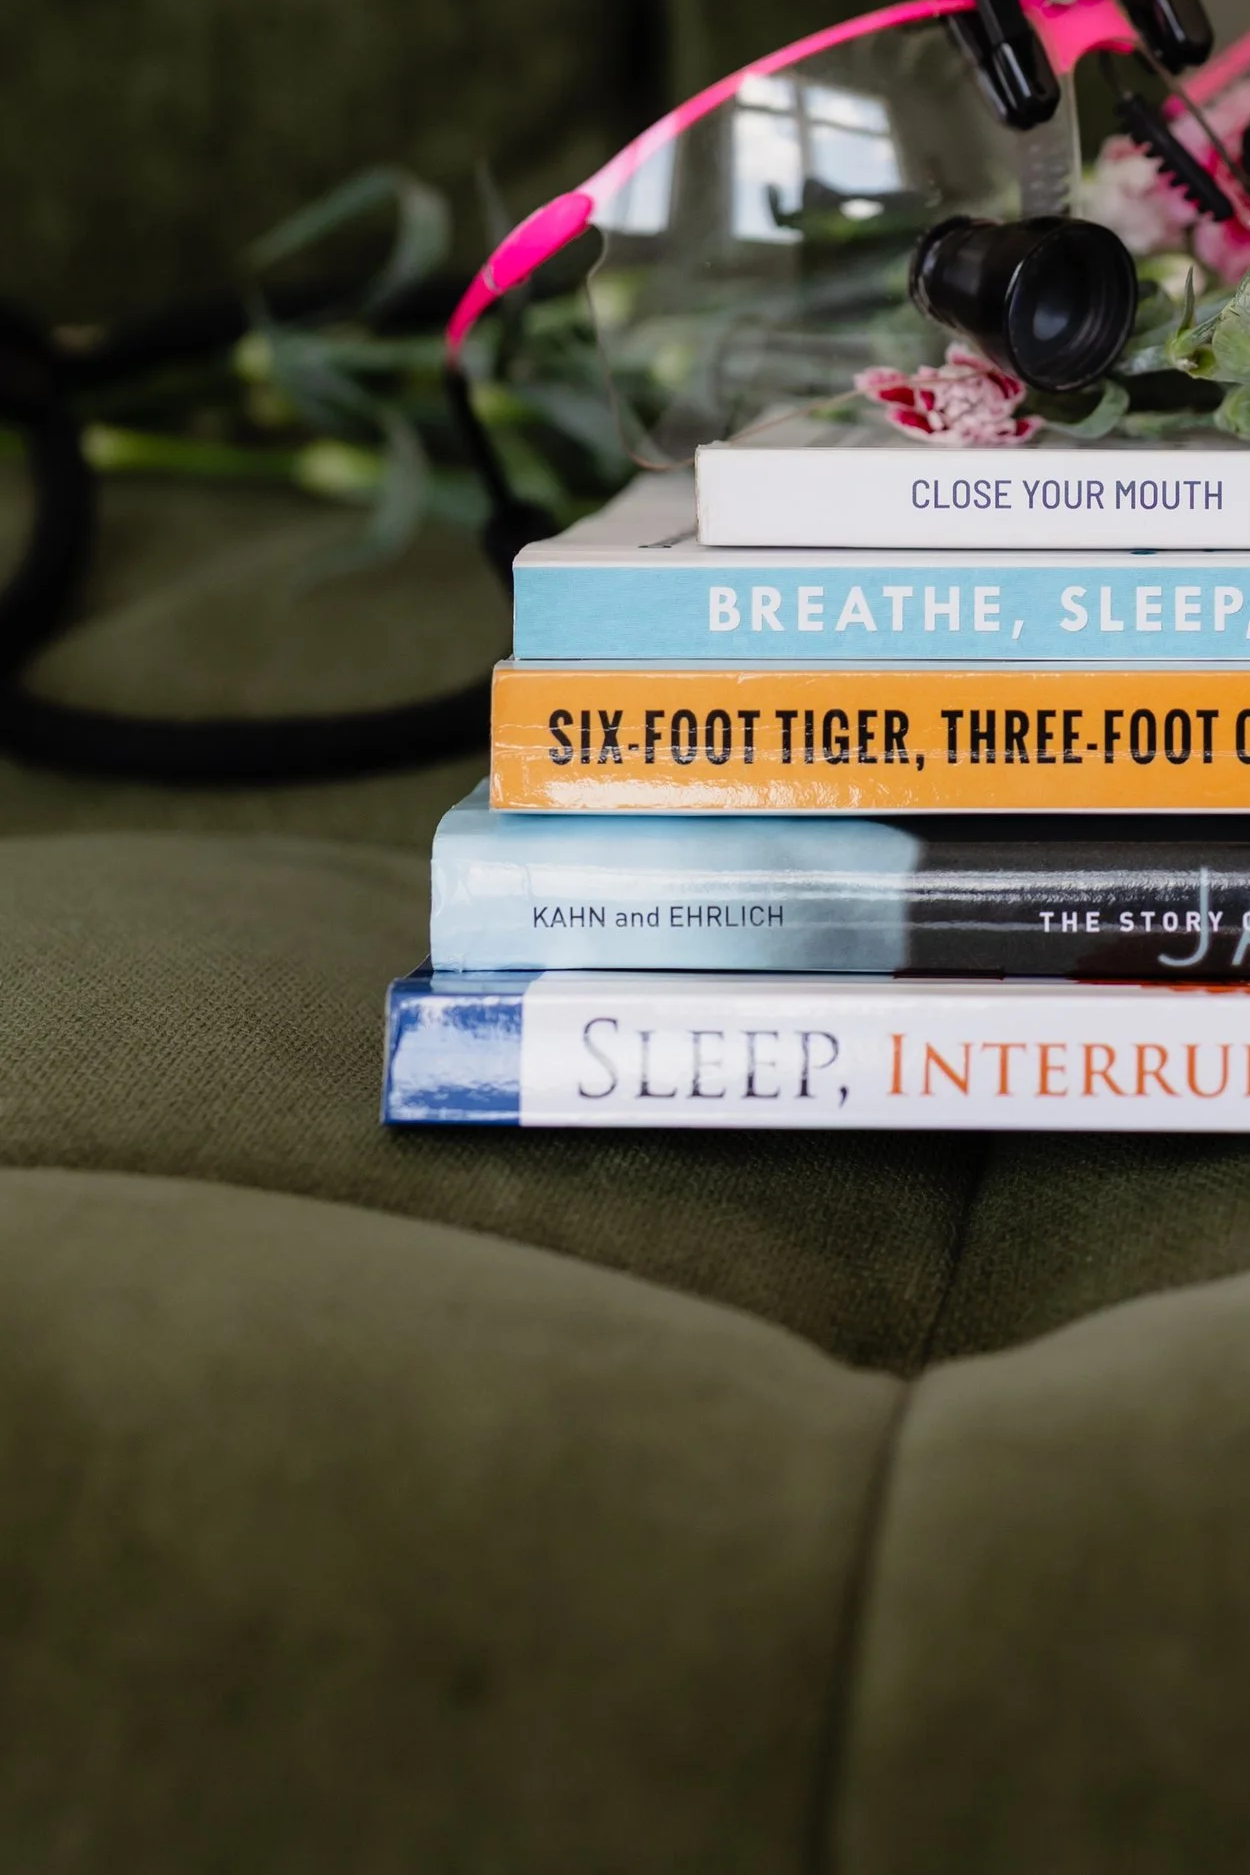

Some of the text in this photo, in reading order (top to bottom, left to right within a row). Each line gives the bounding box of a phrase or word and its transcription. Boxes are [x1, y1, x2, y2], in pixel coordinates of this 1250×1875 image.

[911, 479, 1223, 511] CLOSE YOUR MOUTH
[709, 585, 1024, 640] BREATHE,
[548, 708, 761, 766] SIX-FOOT
[774, 708, 925, 772] TIGER,
[940, 707, 1220, 766] THREE-FOOT
[533, 904, 784, 928] KAHN and EHRLICH
[1039, 910, 1101, 933] THE
[1118, 910, 1224, 933] STORY
[577, 1016, 850, 1108] SLEEP,
